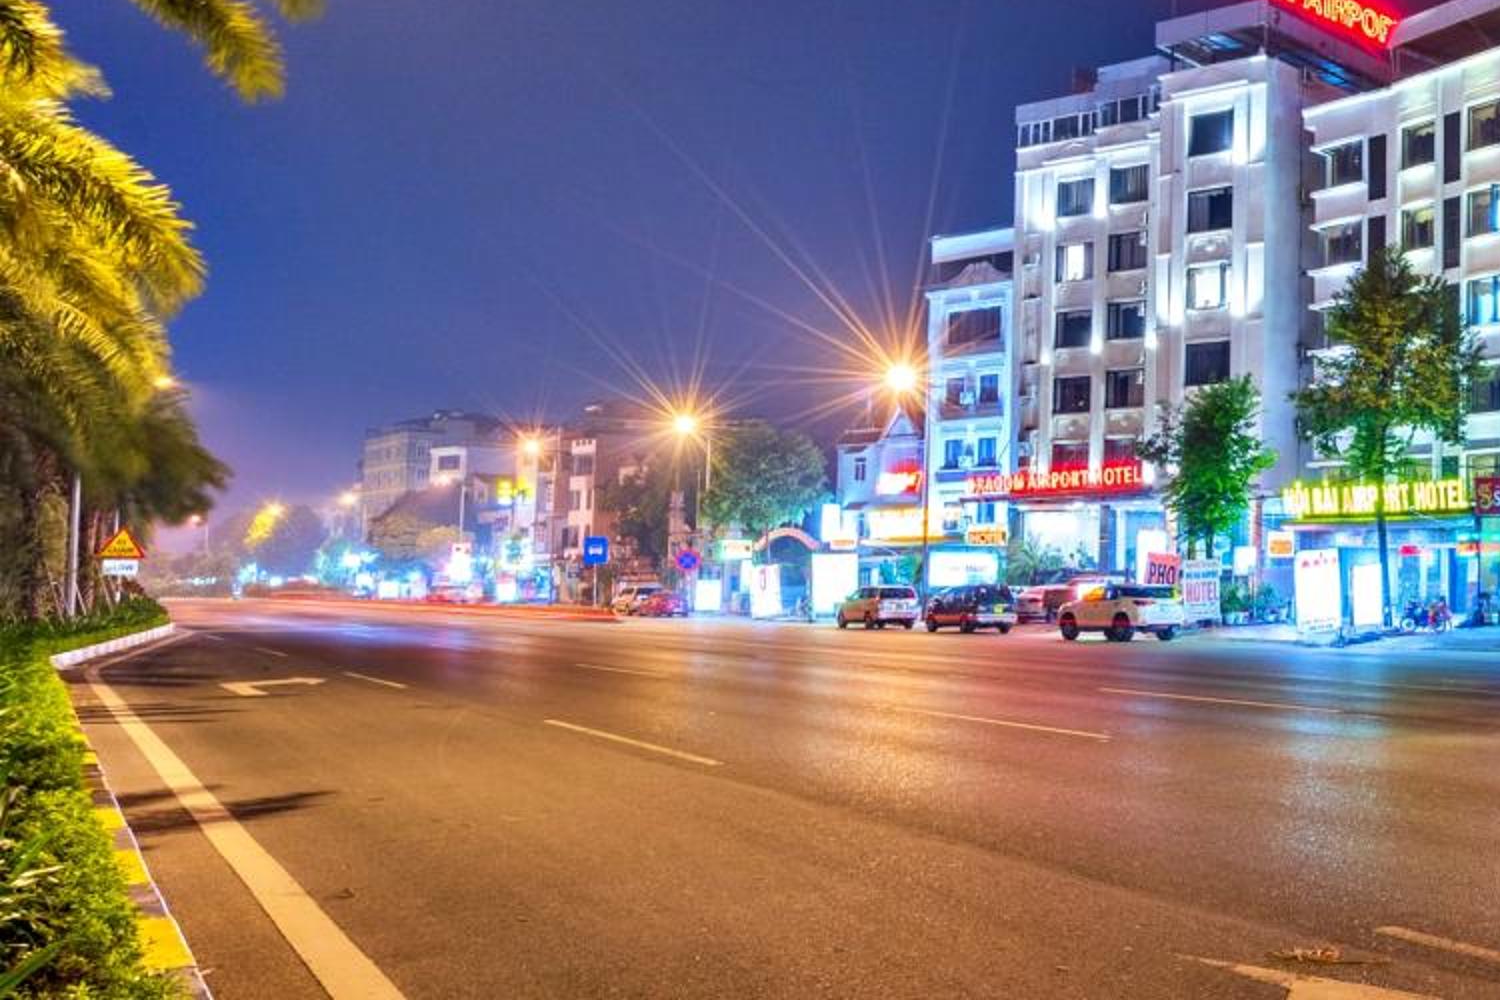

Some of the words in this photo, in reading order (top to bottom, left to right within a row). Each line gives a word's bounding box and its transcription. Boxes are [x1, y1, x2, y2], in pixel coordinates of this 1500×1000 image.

[1027, 468, 1089, 490] AIRPORT
[1412, 477, 1469, 511] HOTEL
[1185, 580, 1219, 602] HOTEL
